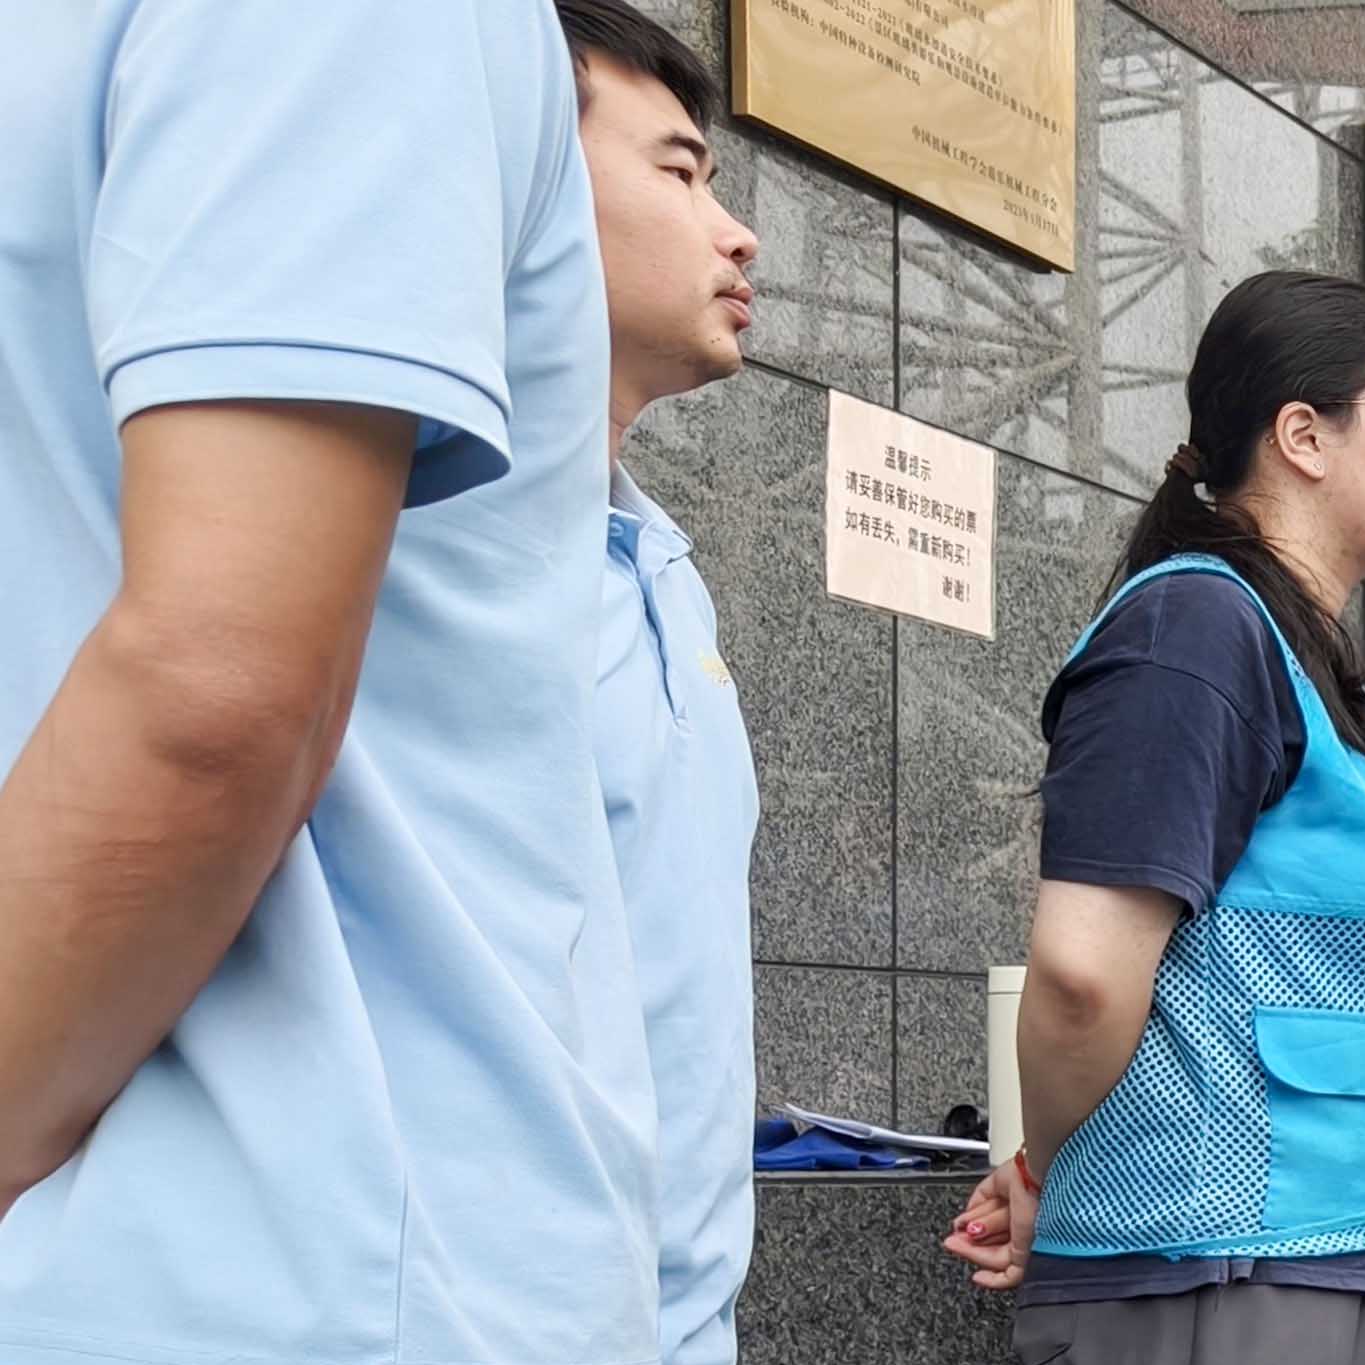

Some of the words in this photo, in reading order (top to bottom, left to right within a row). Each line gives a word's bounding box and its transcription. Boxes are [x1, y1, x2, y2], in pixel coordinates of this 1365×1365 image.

[885, 446, 931, 481] 温馨提示
[845, 469, 976, 533] 请妥善保管好您购买的票
